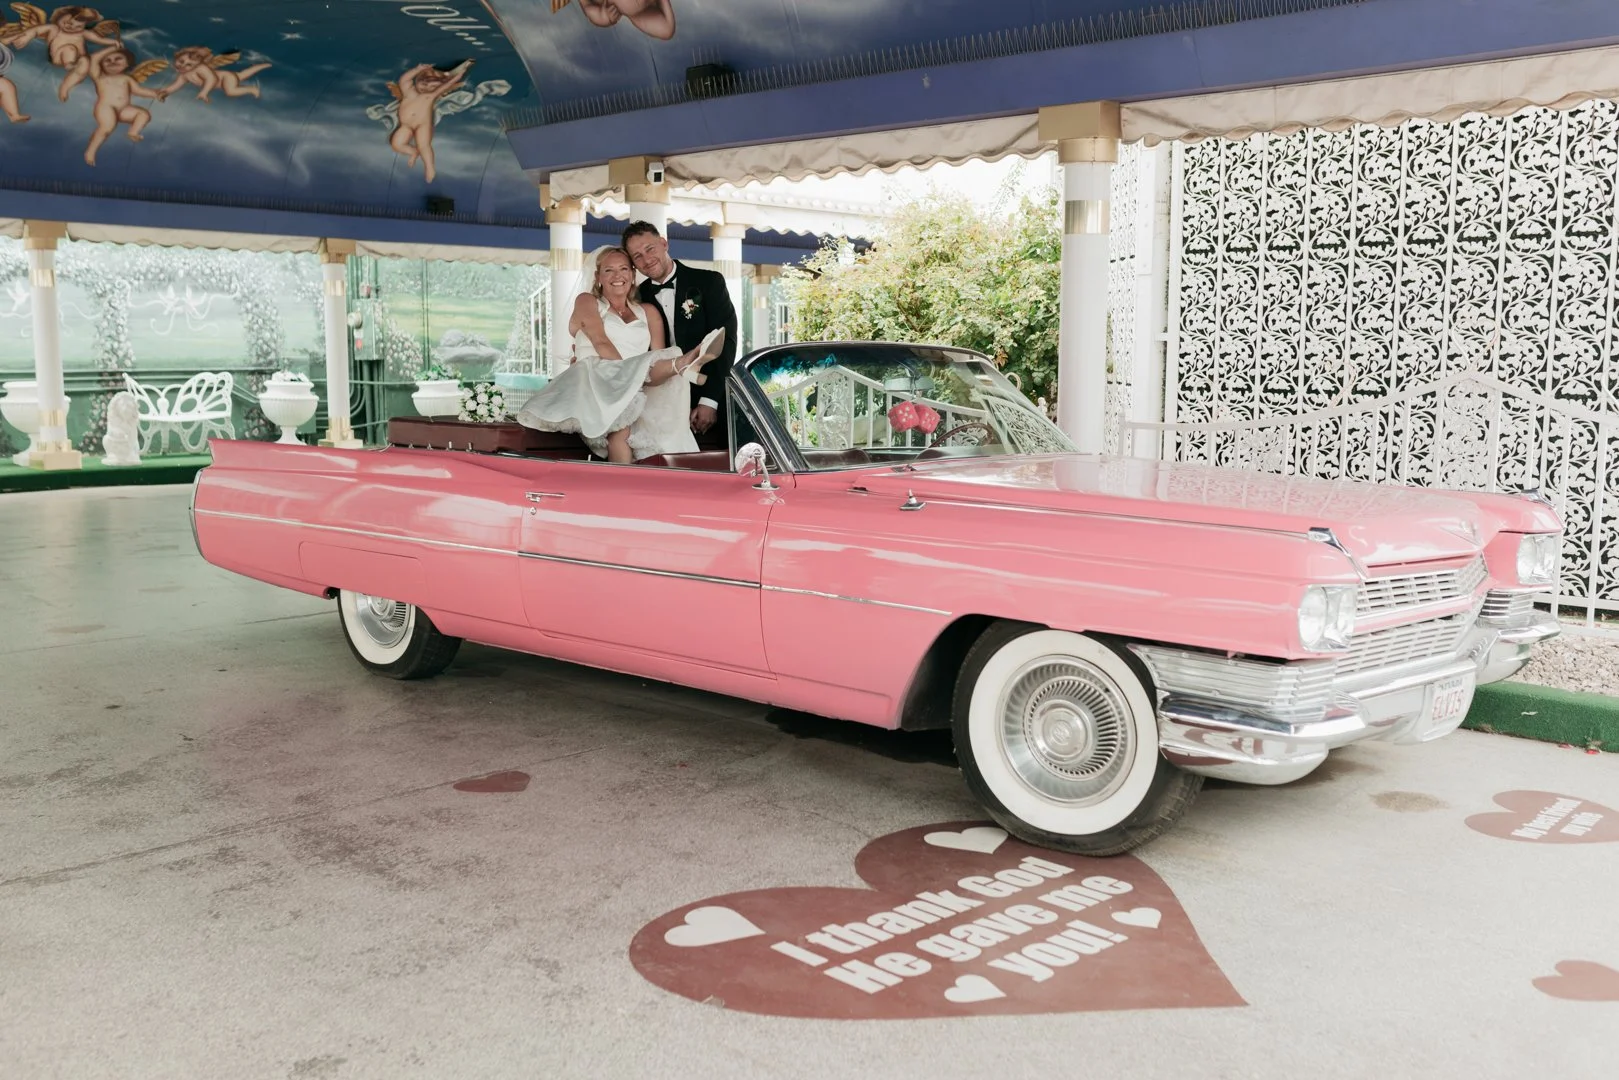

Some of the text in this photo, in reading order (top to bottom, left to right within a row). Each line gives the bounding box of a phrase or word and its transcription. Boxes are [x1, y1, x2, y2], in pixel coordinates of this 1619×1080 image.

[1432, 689, 1465, 721] ELVIS
[770, 856, 1075, 967] I thank God
[824, 875, 1134, 994] He gave me
[986, 919, 1129, 983] you!
